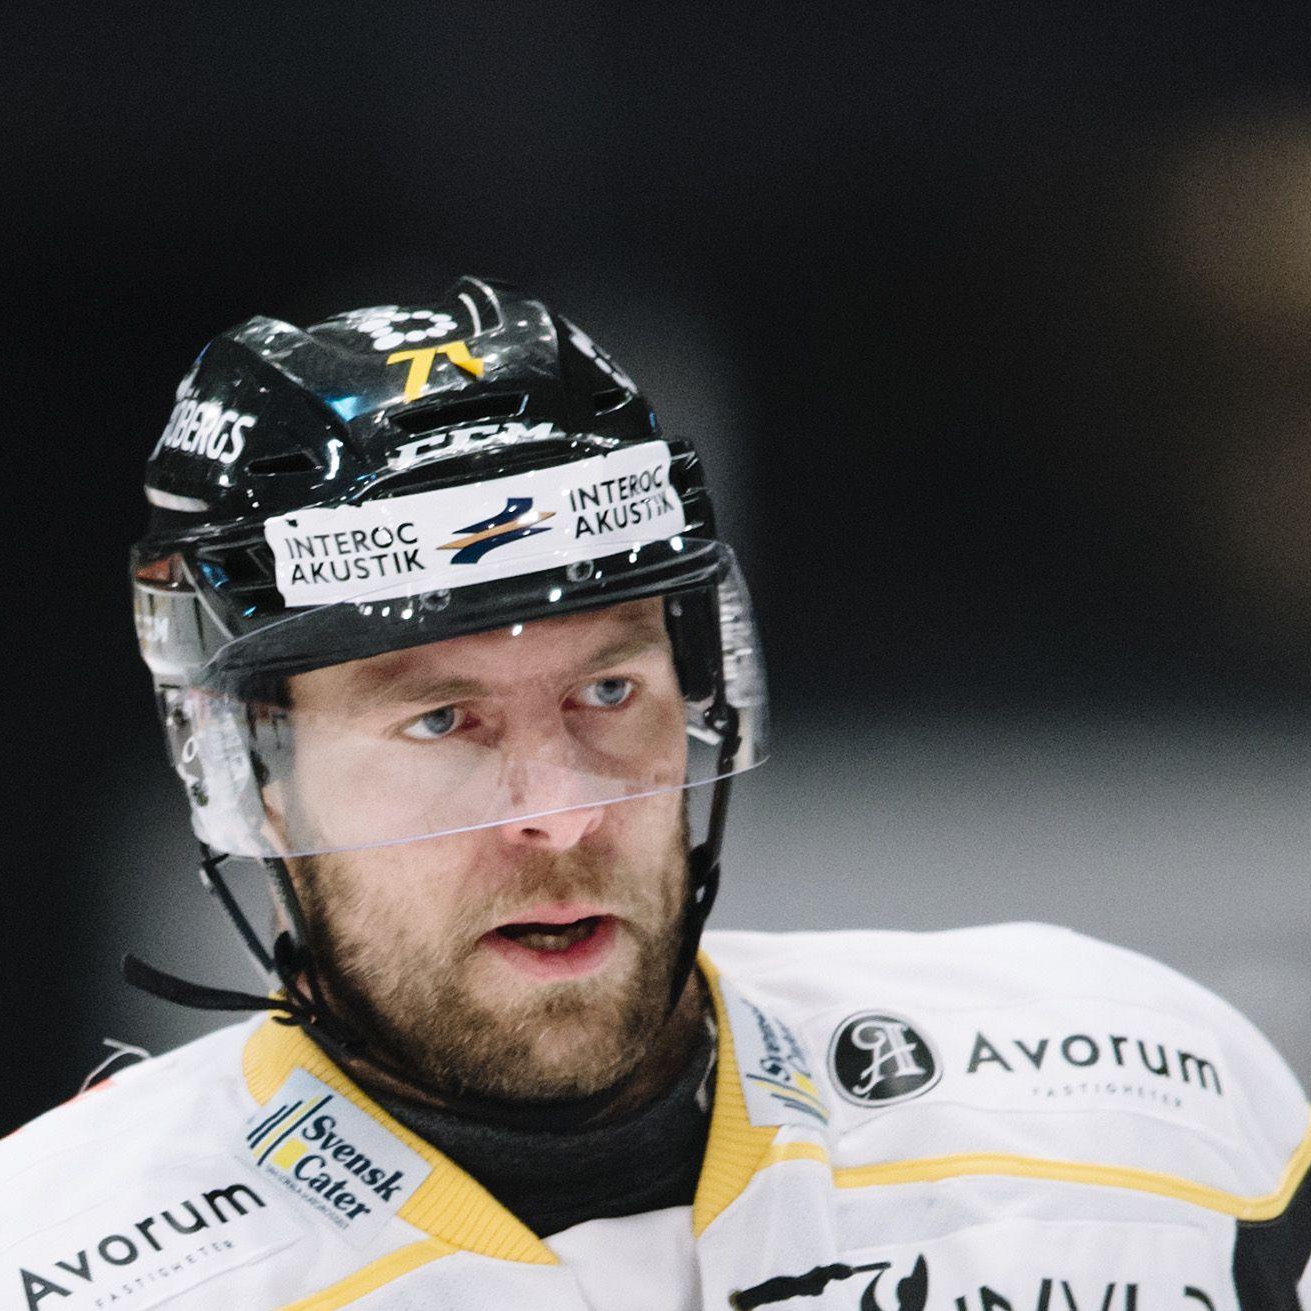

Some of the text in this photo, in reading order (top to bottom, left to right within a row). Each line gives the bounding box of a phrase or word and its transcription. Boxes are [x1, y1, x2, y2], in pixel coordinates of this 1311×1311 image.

[386, 421, 555, 471] CCM
[569, 464, 664, 513] INTEROC
[574, 488, 676, 540] AKUSTIK
[285, 522, 419, 560] INTEROC
[291, 549, 426, 585] AKUSTIK
[967, 1030, 1222, 1095] Avorum
[301, 1114, 404, 1203] Svensk
[294, 1154, 371, 1221] Cater
[94, 1239, 233, 1309] FASTIGHETER
